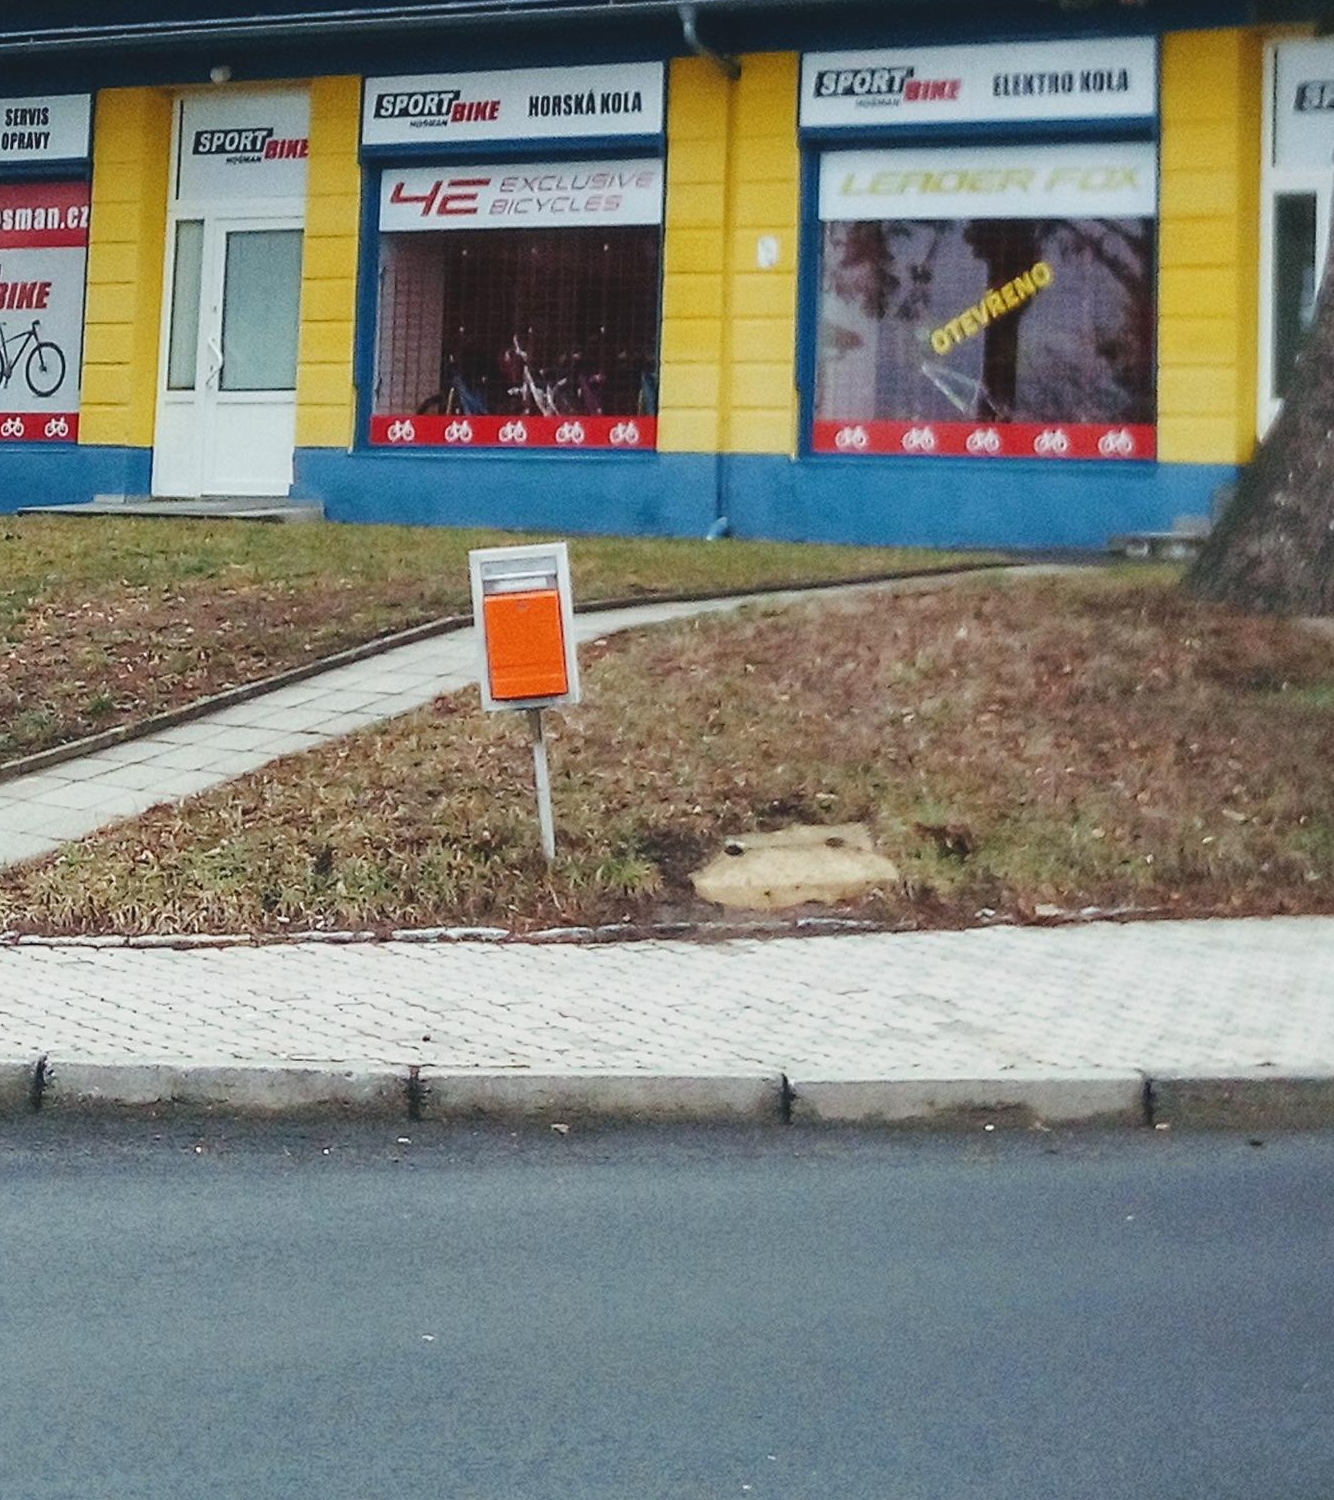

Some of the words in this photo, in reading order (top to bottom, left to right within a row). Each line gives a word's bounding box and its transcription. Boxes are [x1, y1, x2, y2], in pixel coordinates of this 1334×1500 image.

[819, 68, 910, 95] SPORT
[903, 78, 962, 101] BIKE
[992, 72, 1072, 97] ELEKTRO
[1079, 68, 1129, 93] KOLA
[5, 107, 49, 127] SERVIS
[379, 92, 455, 118] SPORT
[450, 100, 501, 123] BIKE
[528, 89, 596, 117] HORSKÁ
[600, 91, 642, 115] KOLA
[1, 132, 51, 150] OPRAVY
[198, 130, 268, 152] SPORT
[264, 139, 309, 159] BIKE
[499, 170, 655, 193] EXCLUSIVE
[841, 168, 1037, 197] LEADER
[1044, 167, 1139, 191] FOX
[489, 195, 623, 215] BICYCLES
[930, 260, 1053, 356] OTEVŘENO
